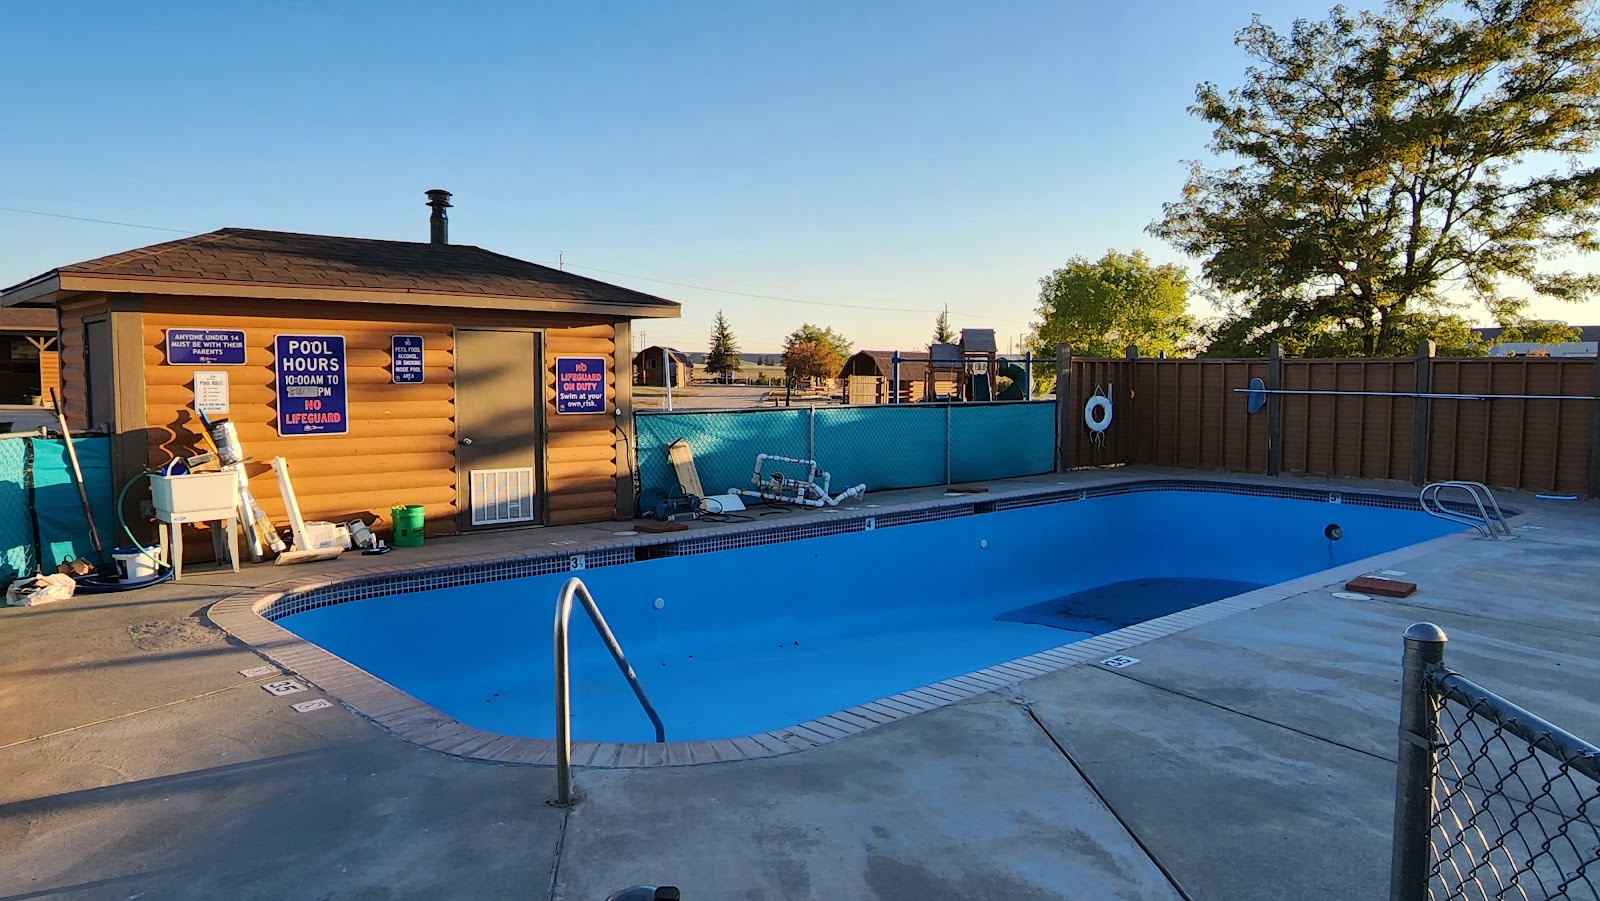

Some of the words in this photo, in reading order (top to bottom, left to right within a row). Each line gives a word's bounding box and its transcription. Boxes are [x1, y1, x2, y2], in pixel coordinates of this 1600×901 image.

[289, 340, 332, 354] POOL
[283, 358, 339, 371] HOURS
[576, 363, 587, 372] NO
[285, 375, 324, 385] 10:00AM
[327, 375, 339, 384] TO
[563, 383, 575, 391] ON
[577, 383, 597, 391] DUTY
[304, 400, 321, 410] NO
[286, 412, 341, 424] LIFEGUARD
